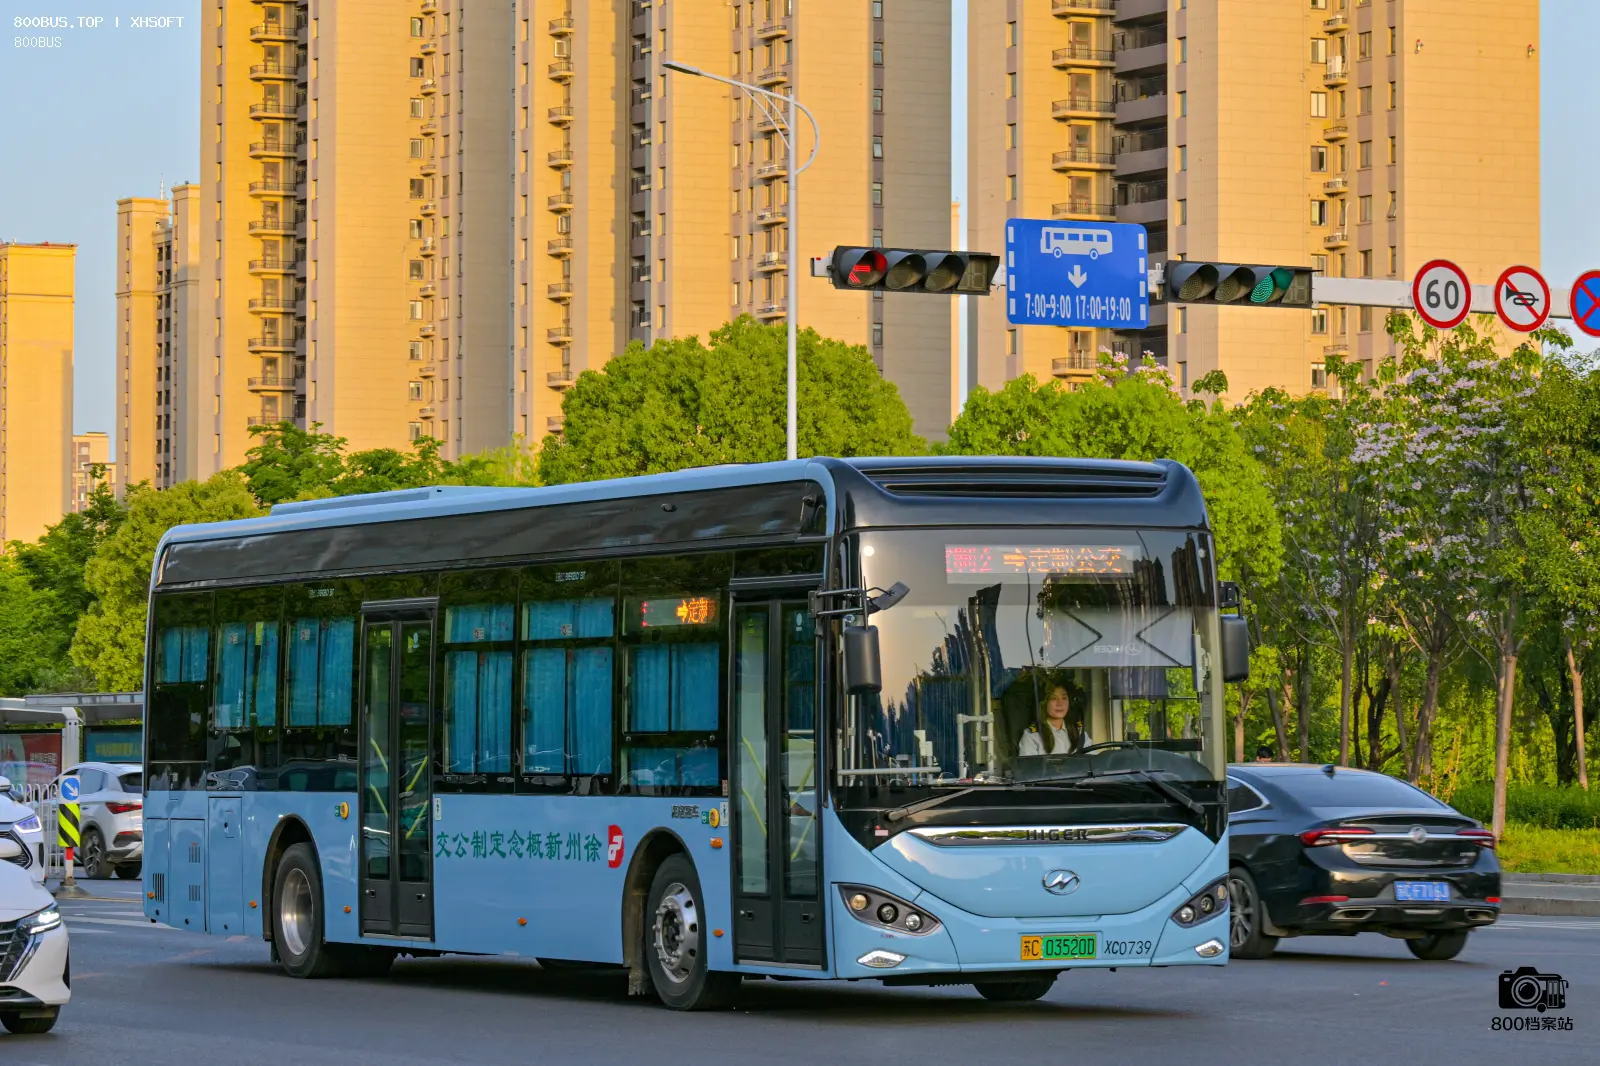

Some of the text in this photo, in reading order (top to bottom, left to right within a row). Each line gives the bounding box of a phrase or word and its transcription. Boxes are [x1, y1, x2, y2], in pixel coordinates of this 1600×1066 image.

[1425, 279, 1460, 310] 60
[1024, 293, 1132, 321] 7:00-9:00 17:00-19:00
[1026, 828, 1088, 841] HIGER
[1045, 938, 1095, 956] 03520D
[1104, 940, 1152, 956] XC0739
